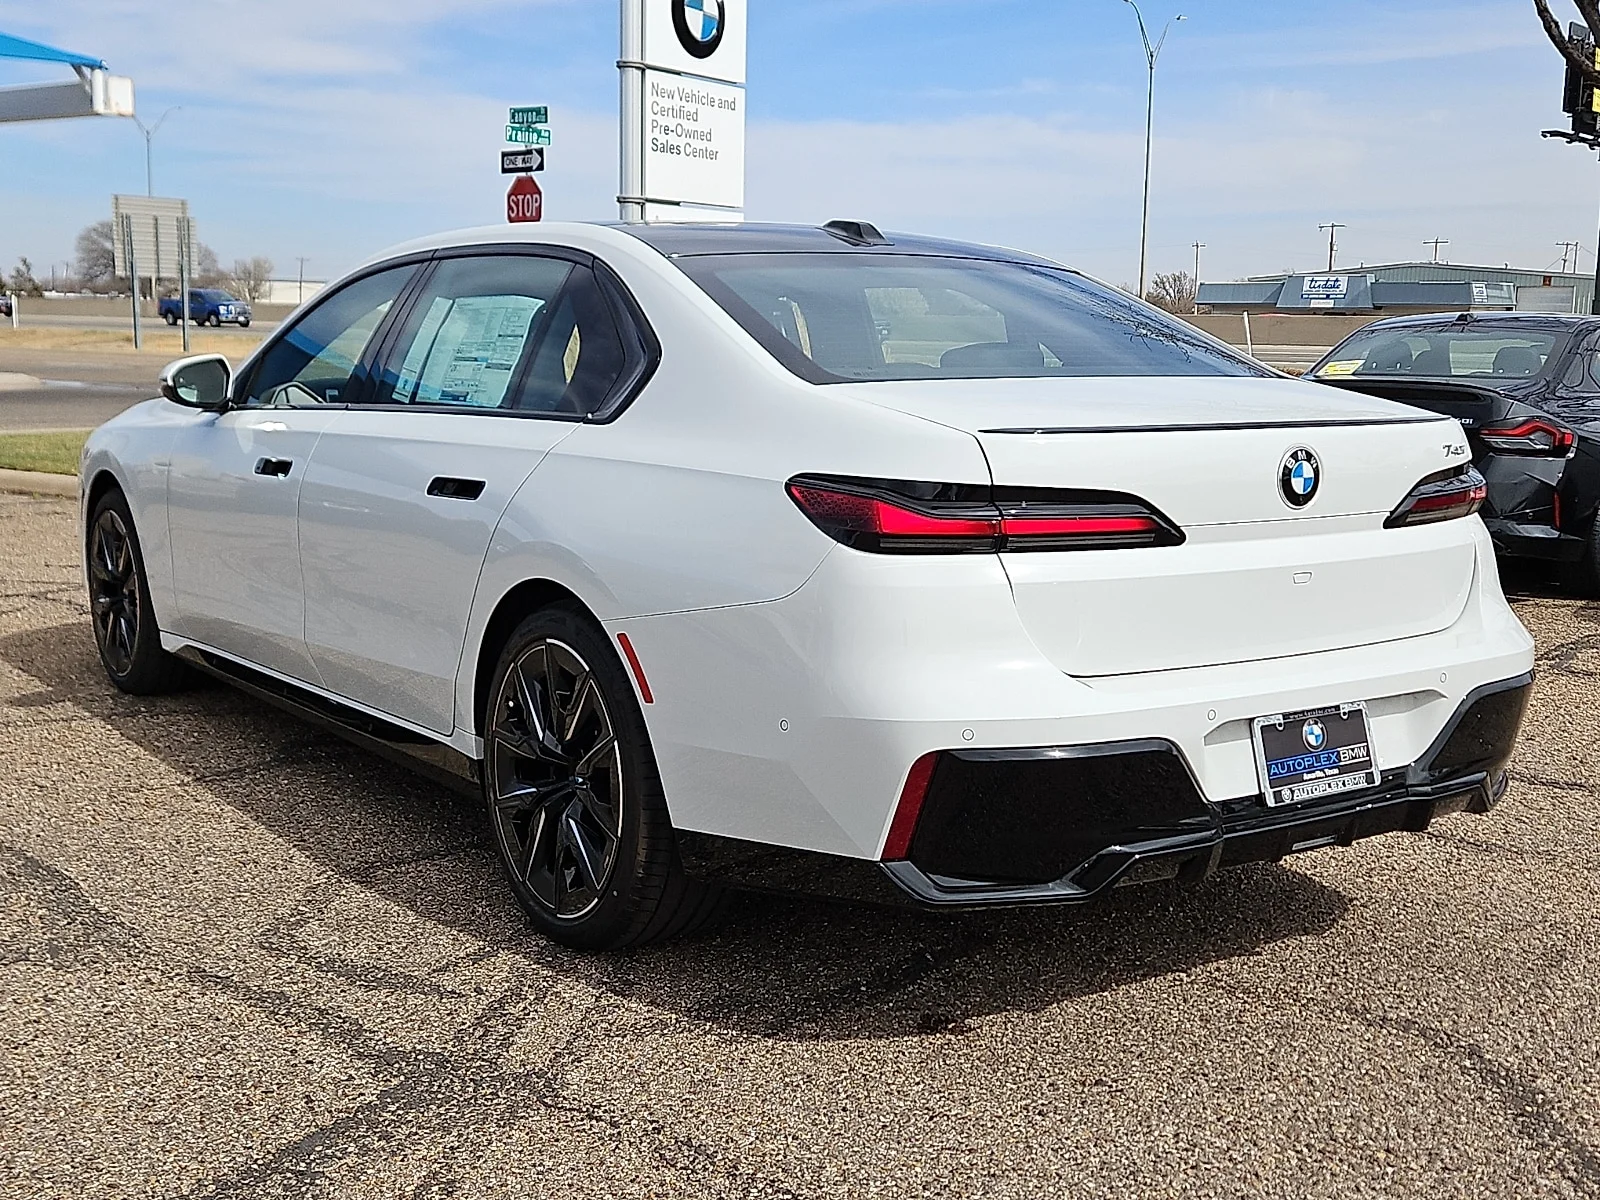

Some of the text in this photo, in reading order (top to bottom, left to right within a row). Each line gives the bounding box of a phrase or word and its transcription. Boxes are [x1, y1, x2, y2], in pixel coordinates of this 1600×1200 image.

[651, 82, 736, 111] New Vehicle and
[510, 109, 537, 124] Canyon
[651, 101, 698, 122] Certified
[506, 126, 538, 143] Prairie
[651, 119, 712, 142] Pre-Owned
[651, 138, 719, 160] Sales Center
[505, 156, 533, 166] ONE WAY
[509, 194, 540, 217] STOP
[1285, 450, 1318, 469] BMW
[1270, 746, 1368, 775] AUTOPLEX BMW
[1293, 773, 1367, 800] AUTOPLEX BMW
